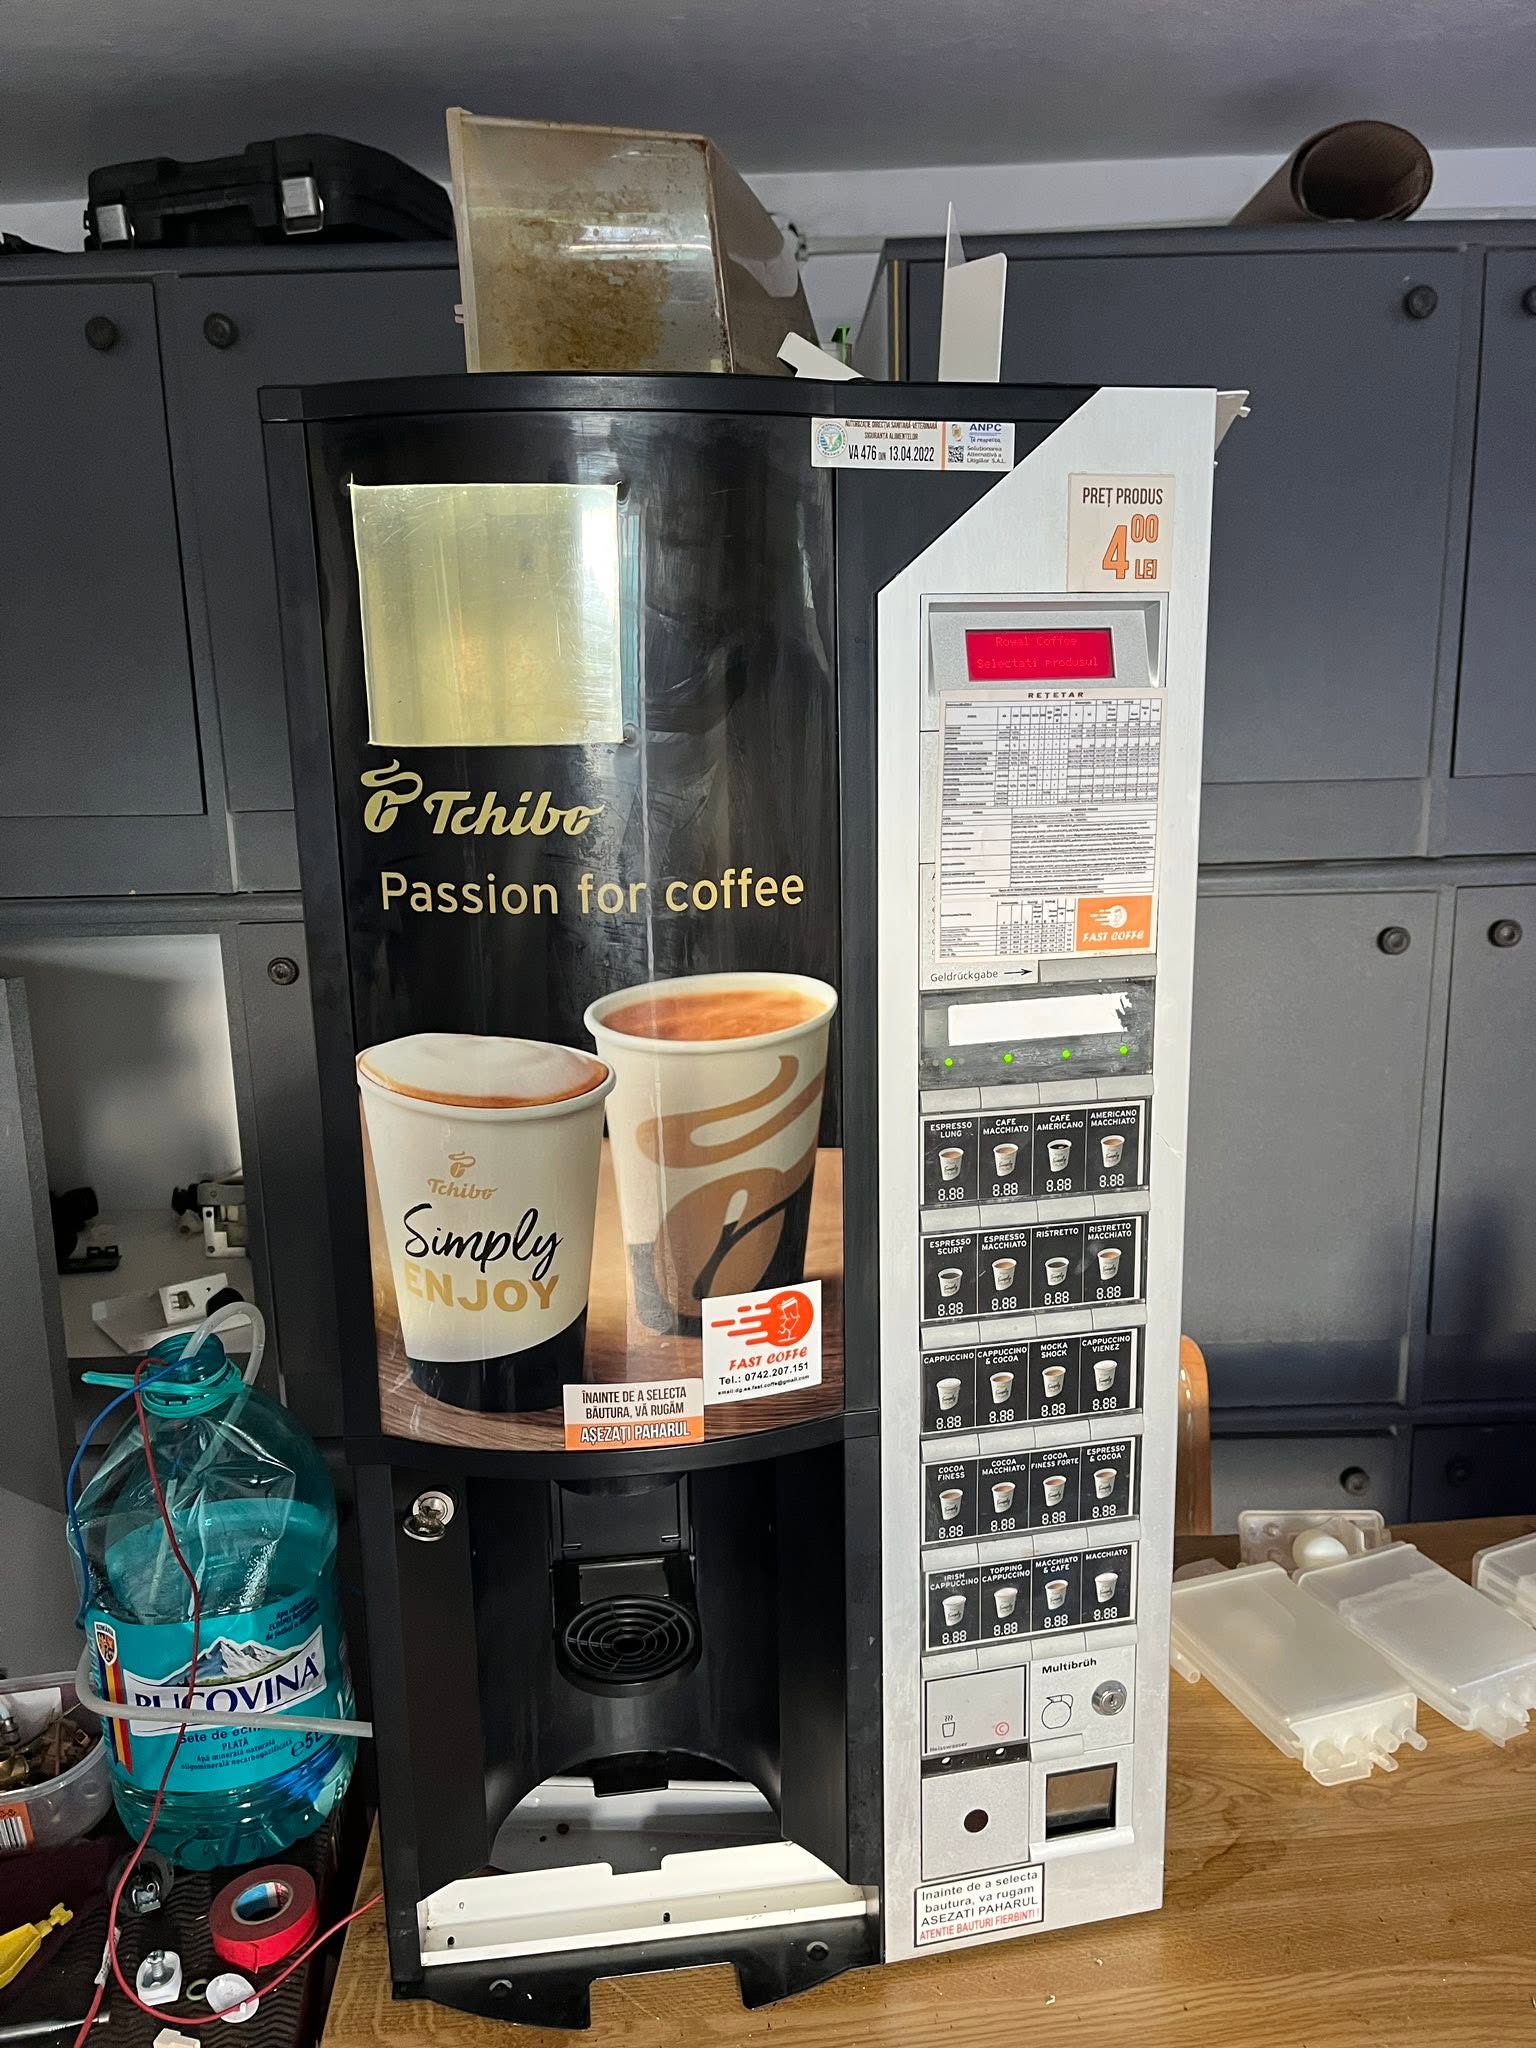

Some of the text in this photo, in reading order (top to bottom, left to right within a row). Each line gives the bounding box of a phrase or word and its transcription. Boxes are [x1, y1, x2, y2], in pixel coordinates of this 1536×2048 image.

[848, 445, 859, 460] VA
[861, 446, 876, 460] 476
[889, 446, 934, 462] 13.04.2022
[1083, 487, 1163, 507] PREȚ PRODUS
[1102, 514, 1159, 579] 4 00 LEI
[1036, 636, 1077, 646] Coffee
[423, 791, 605, 836] Tchibo
[381, 867, 805, 915] Passion for coffee
[1082, 932, 1107, 943] FAST
[931, 970, 998, 982] Geldrückgabe
[1091, 1109, 1137, 1119] AMERICANO
[930, 1121, 972, 1131] ESPRESSO
[996, 1118, 1016, 1126] CAFE
[1037, 1121, 1083, 1131] AMERICANO
[1091, 1118, 1136, 1127] MACCHIATO
[983, 1126, 1029, 1135] MACCHIATO
[1046, 1178, 1071, 1192] 8.88
[1100, 1174, 1124, 1187] 8.88
[427, 1178, 498, 1200] Tchibo
[938, 1187, 964, 1201] 8.88
[992, 1183, 1018, 1196] 8.88
[1036, 1228, 1079, 1238] RISTRETTO
[1089, 1223, 1131, 1233] RISTRETTO
[984, 1233, 1025, 1243] ESPRESSO
[1088, 1230, 1132, 1240] MACCHIATO
[404, 1203, 563, 1281] Simply
[930, 1238, 971, 1248] ESPRESSO
[982, 1241, 1027, 1251] MACCHIATO
[937, 1246, 963, 1255] SCURT
[405, 1260, 560, 1312] ENJOY
[1044, 1292, 1069, 1305] 8.88
[1097, 1286, 1121, 1299] 8.88
[938, 1302, 963, 1316] 8.88
[992, 1297, 1016, 1310] 8.88
[1041, 1342, 1068, 1351] MOCKA
[1082, 1336, 1130, 1346] CAPPUCCINO
[977, 1347, 1027, 1358] CAPPUCCINO
[1041, 1350, 1067, 1358] SHOCK
[1092, 1344, 1119, 1352] VIENEZ
[729, 1347, 807, 1370] FAST COFFE
[924, 1353, 974, 1364] CAPPUCCINO
[993, 1355, 1019, 1364] COCOA
[719, 1362, 808, 1385] Tel.: 0742.207.151
[582, 1386, 687, 1404] ÎNAINTE DE A SELECTA
[1093, 1397, 1117, 1410] 8.88
[586, 1401, 684, 1420] BĂUTURA, VĂ RUGĂM
[1041, 1403, 1066, 1417] 8.88
[989, 1410, 1014, 1423] 8.88
[936, 1416, 961, 1430] 8.88
[580, 1420, 690, 1445] AȘEZAȚI PAHARUL
[1043, 1452, 1067, 1461] COCOA
[1087, 1445, 1125, 1456] ESPRESSO
[991, 1459, 1016, 1467] COCOA
[1097, 1453, 1121, 1461] COCOA
[939, 1465, 964, 1473] COCOA
[982, 1464, 1026, 1475] MACCHIATO
[1031, 1458, 1079, 1469] FINESS FORTE
[938, 1471, 965, 1480] FINESS
[1092, 1504, 1116, 1518] 8.88
[1042, 1511, 1066, 1525] 8.88
[991, 1518, 1015, 1532] 8.88
[939, 1525, 963, 1538] 8.88
[1086, 1549, 1128, 1560] MACCHIATO
[1035, 1556, 1078, 1568] MACCHIATO
[1051, 1564, 1070, 1572] CAFE
[990, 1564, 1022, 1574] TOPPING
[944, 1573, 965, 1581] IRISH
[982, 1570, 1030, 1582] CAPPUCCINO
[930, 1578, 979, 1590] CAPPUCCINO
[1094, 1607, 1117, 1621] 8.88
[1044, 1615, 1068, 1628] 8.88
[994, 1622, 1018, 1636] 8.88
[942, 1630, 966, 1644] 8.88
[1042, 1658, 1097, 1674] Multibrüh
[212, 1730, 227, 1740] de
[922, 1886, 962, 1901] Inainte
[967, 1882, 981, 1892] de
[996, 1872, 1037, 1886] selecta
[926, 1885, 1034, 1913] bautura, va rugam
[921, 1896, 1038, 1927] ASEZATI PAHARUL
[920, 1925, 954, 1941] ATENTIE
[957, 1918, 993, 1933] BAUTURI
[996, 1911, 1035, 1925] FIERBINTI
